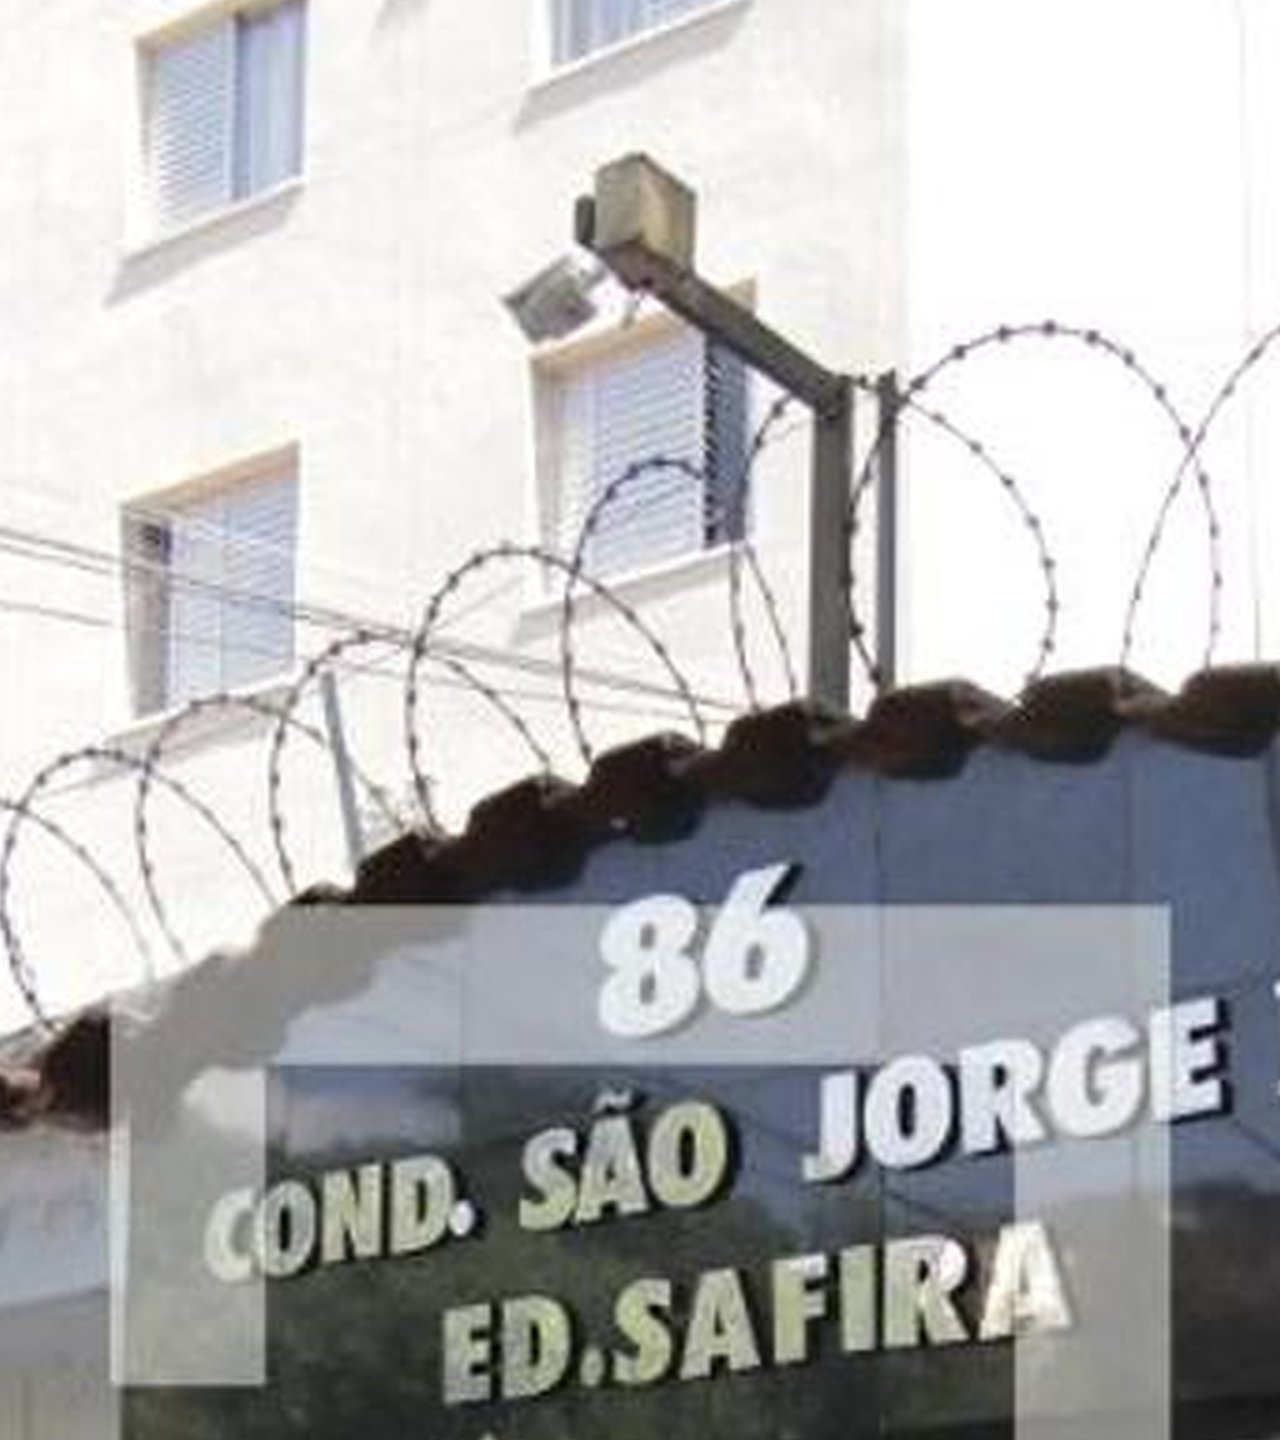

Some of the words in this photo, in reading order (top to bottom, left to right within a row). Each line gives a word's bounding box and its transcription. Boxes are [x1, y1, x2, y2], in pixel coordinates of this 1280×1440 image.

[598, 861, 810, 1037] 86
[204, 1154, 478, 1283] COND.
[518, 1088, 730, 1232] SÃO
[802, 995, 1223, 1182] JORGE
